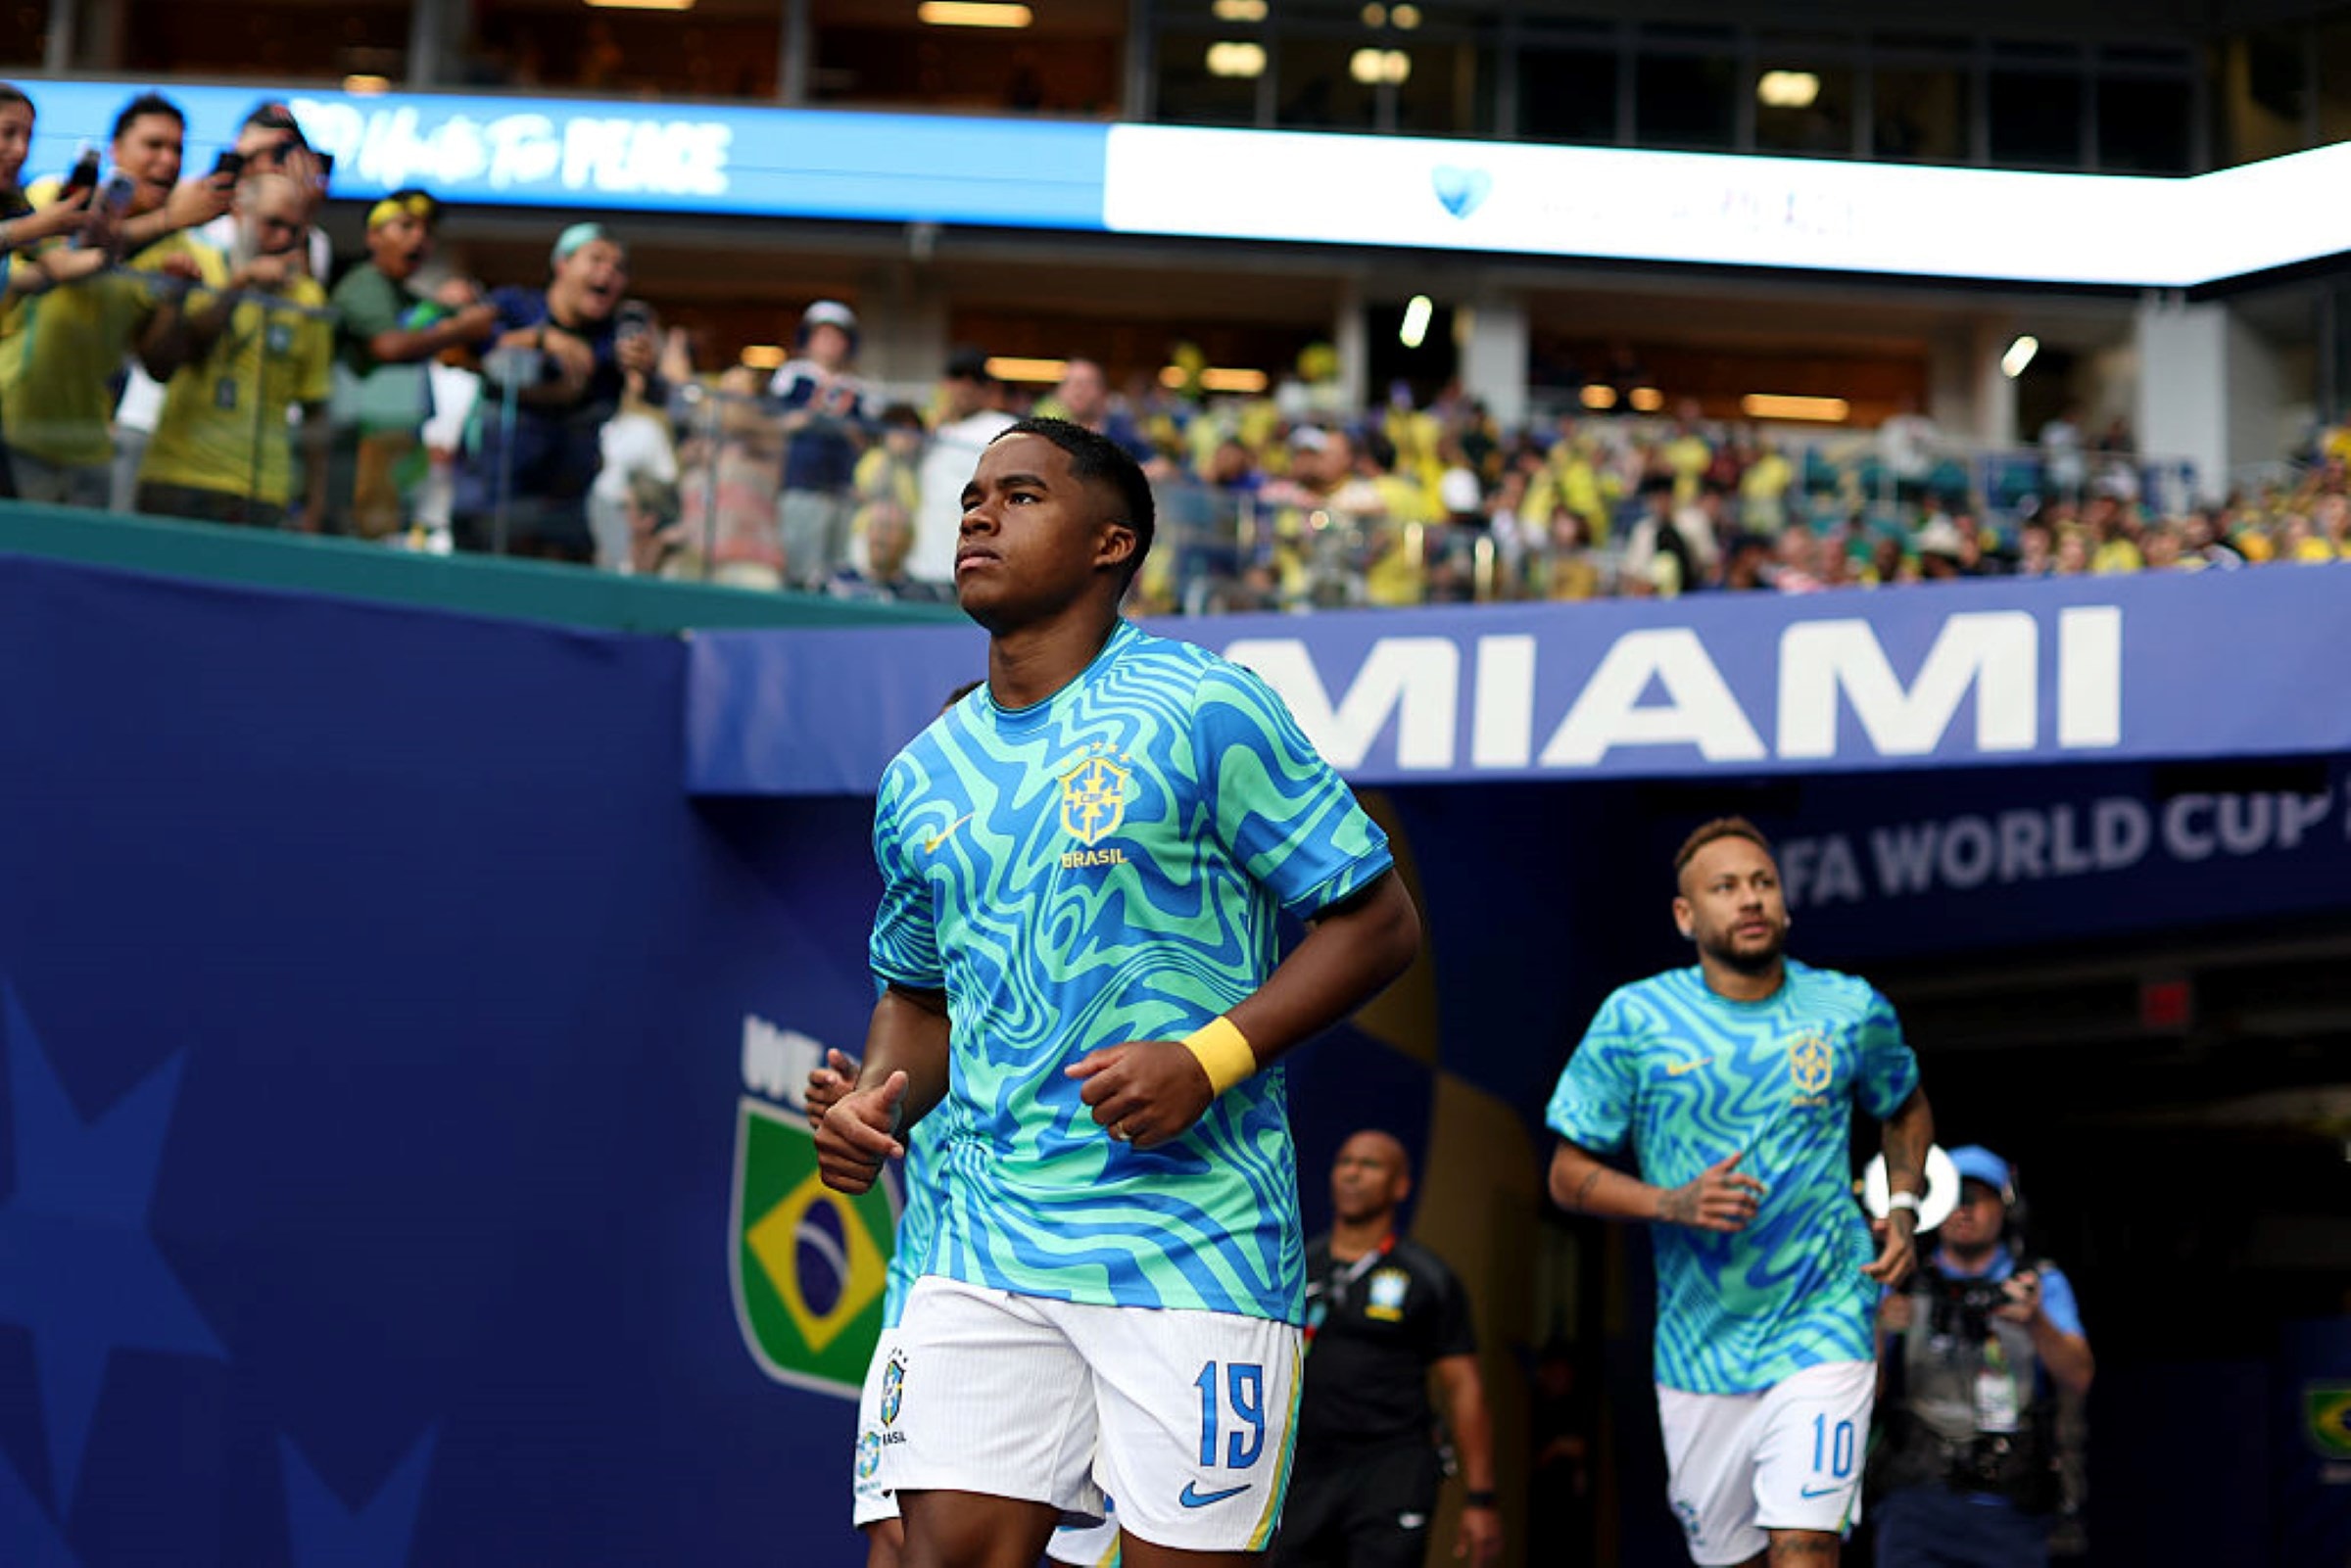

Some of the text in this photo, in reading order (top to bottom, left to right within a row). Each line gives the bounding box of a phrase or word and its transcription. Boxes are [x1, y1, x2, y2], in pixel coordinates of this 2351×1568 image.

[1223, 605, 2122, 770] MIAMI
[1061, 848, 1128, 869] BRASIL
[1780, 832, 1863, 907] FA
[1871, 794, 2151, 891] WORLD
[2163, 788, 2332, 862] CUP
[1193, 1360, 1266, 1469] 19
[1812, 1413, 1854, 1479] 10
